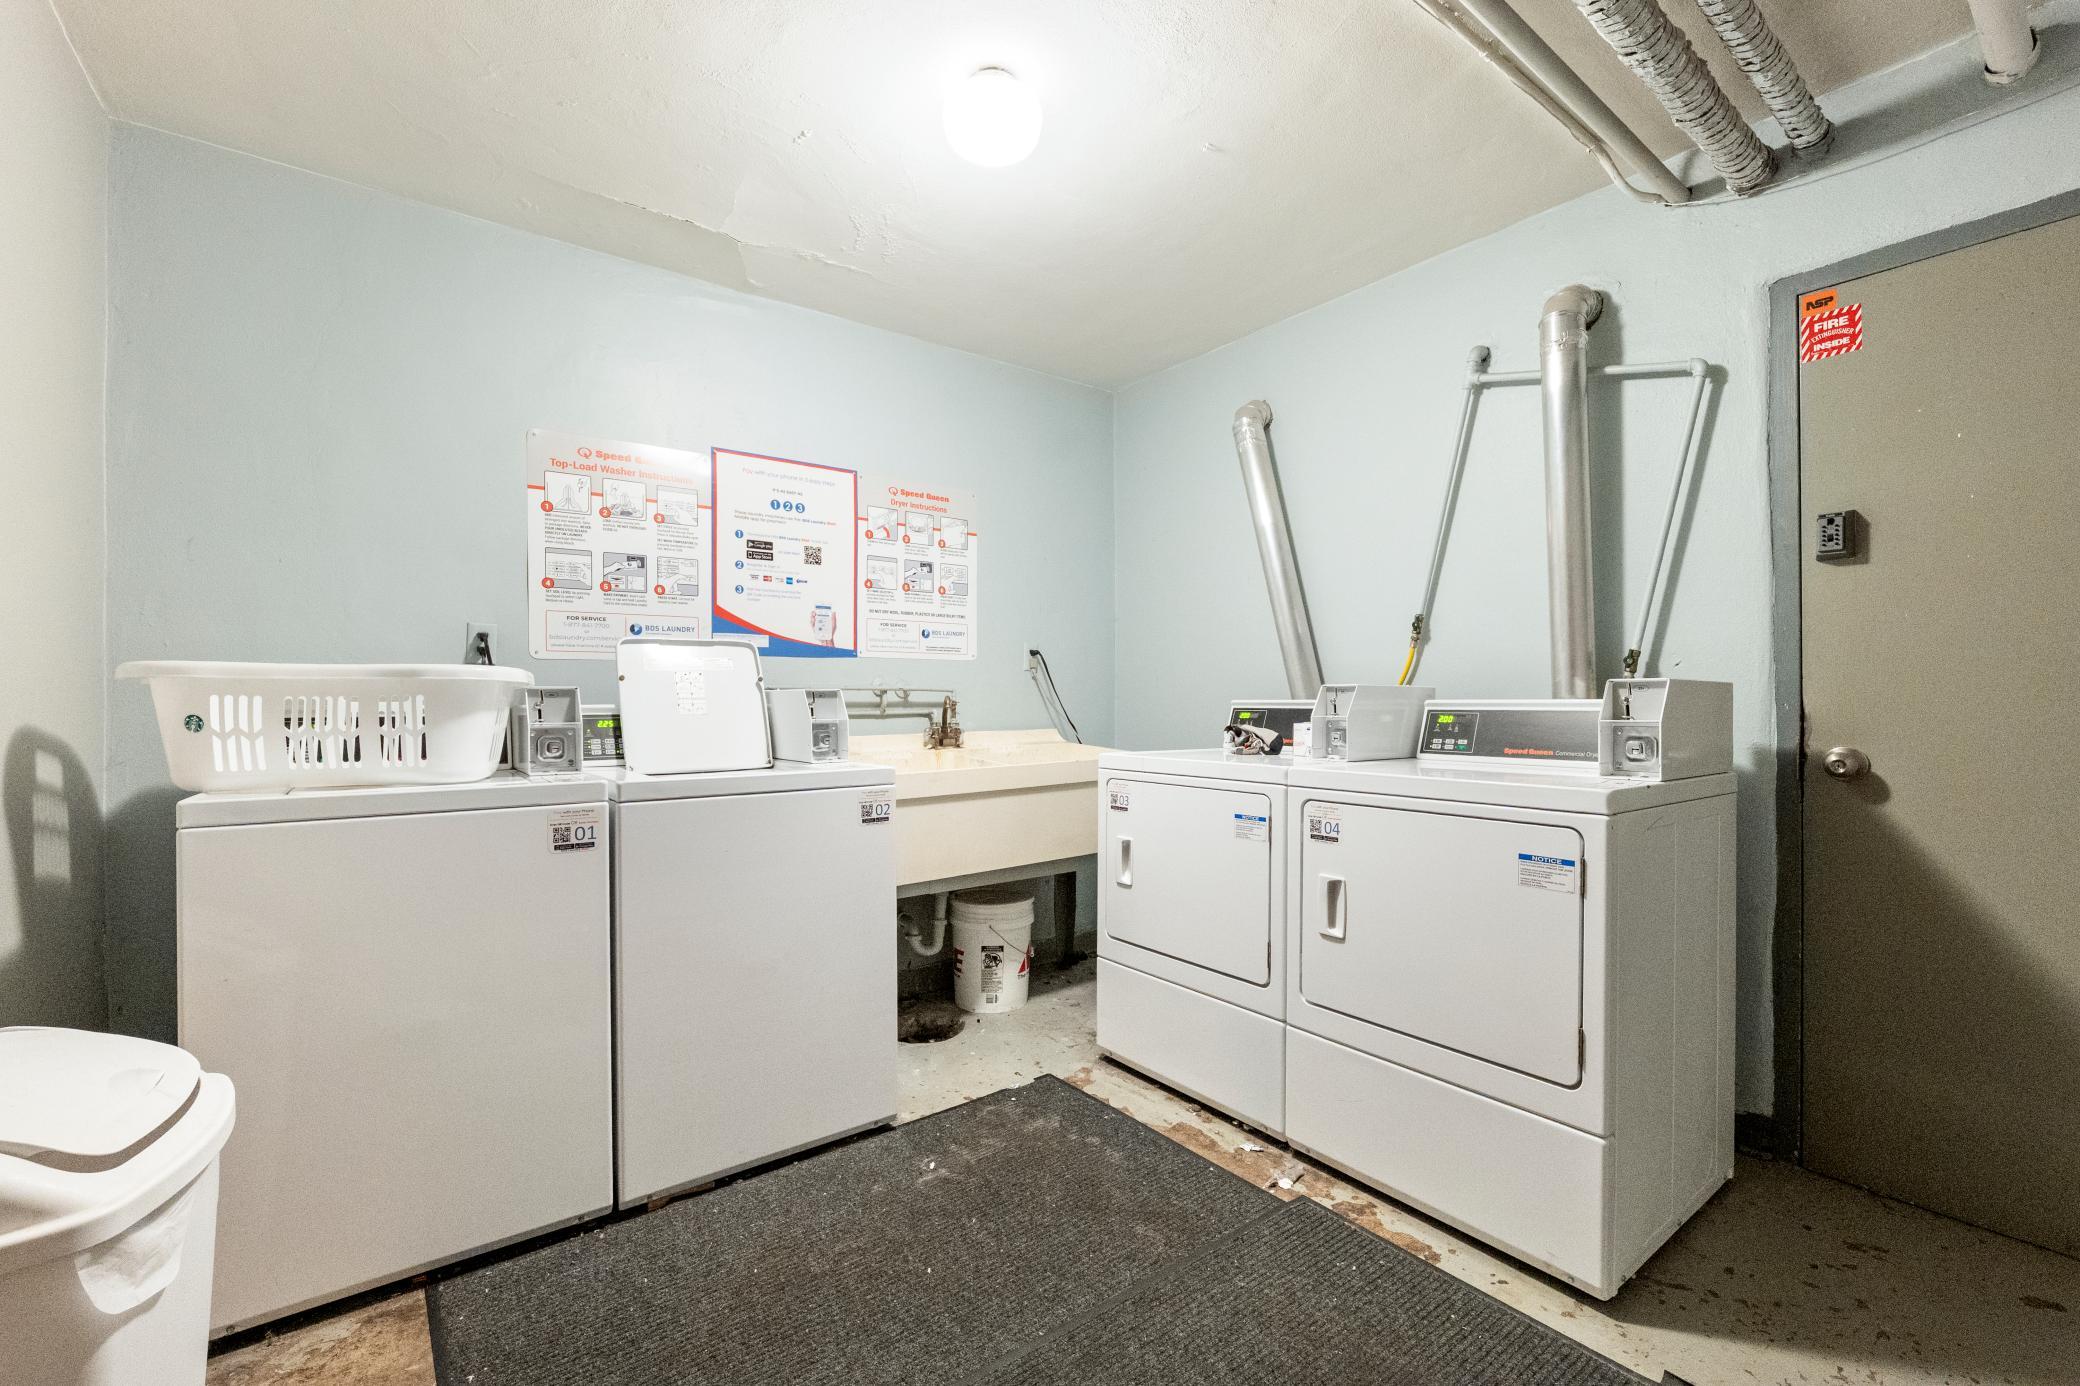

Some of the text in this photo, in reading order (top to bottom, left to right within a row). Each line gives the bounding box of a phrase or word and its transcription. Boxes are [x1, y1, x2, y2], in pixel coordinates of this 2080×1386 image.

[1814, 316, 1849, 332] FIRE
[1810, 328, 1854, 343] EXTINGUISHER
[1814, 336, 1850, 351] INSIDE
[595, 450, 632, 463] Speed
[550, 457, 598, 472] Top-Load
[600, 464, 636, 477] Washer
[900, 488, 950, 502] Speed Queen
[890, 498, 948, 513] Dryer Instructions
[1120, 795, 1129, 806] 03
[876, 804, 890, 816] 02
[574, 825, 597, 841] 01
[1324, 822, 1340, 836] 04
[1531, 855, 1563, 865] NOTICE
